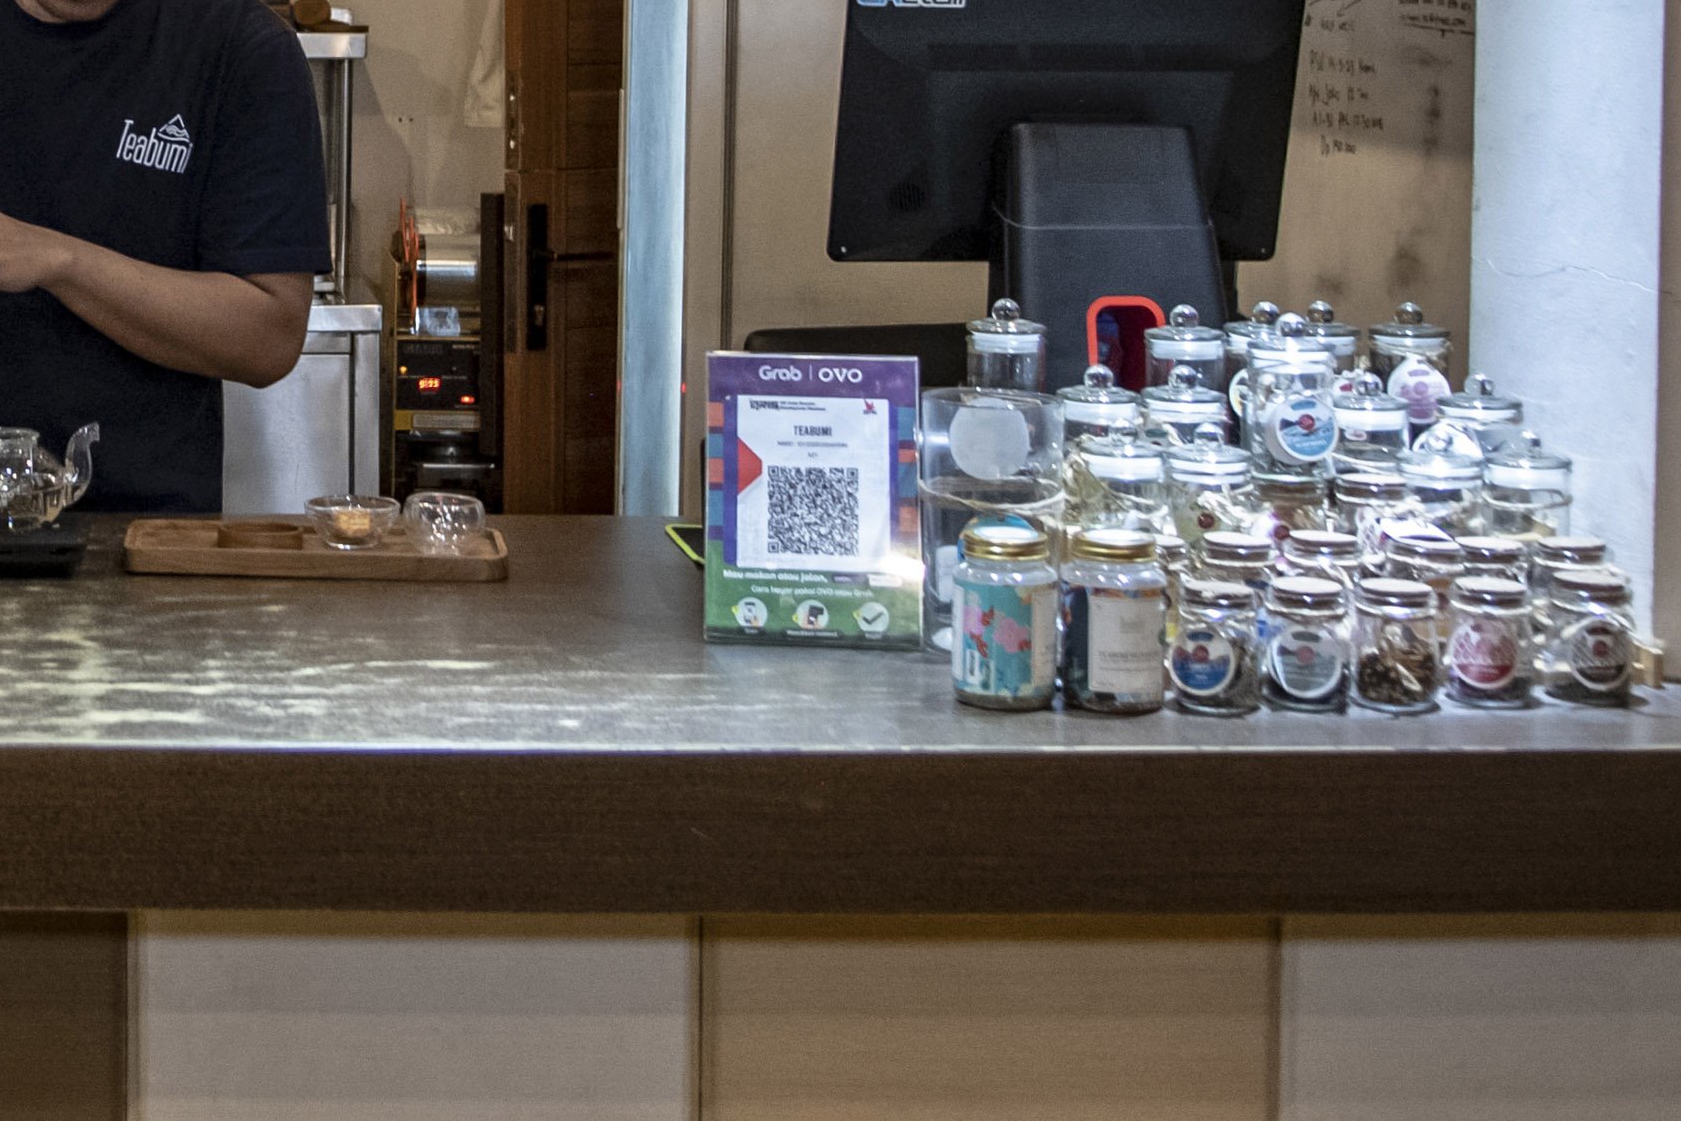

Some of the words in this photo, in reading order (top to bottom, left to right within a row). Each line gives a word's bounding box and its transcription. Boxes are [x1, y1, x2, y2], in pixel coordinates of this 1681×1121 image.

[116, 119, 193, 174] Teabumi
[758, 365, 802, 382] Grab
[818, 367, 863, 383] OVO
[794, 425, 832, 436] TEABUMI
